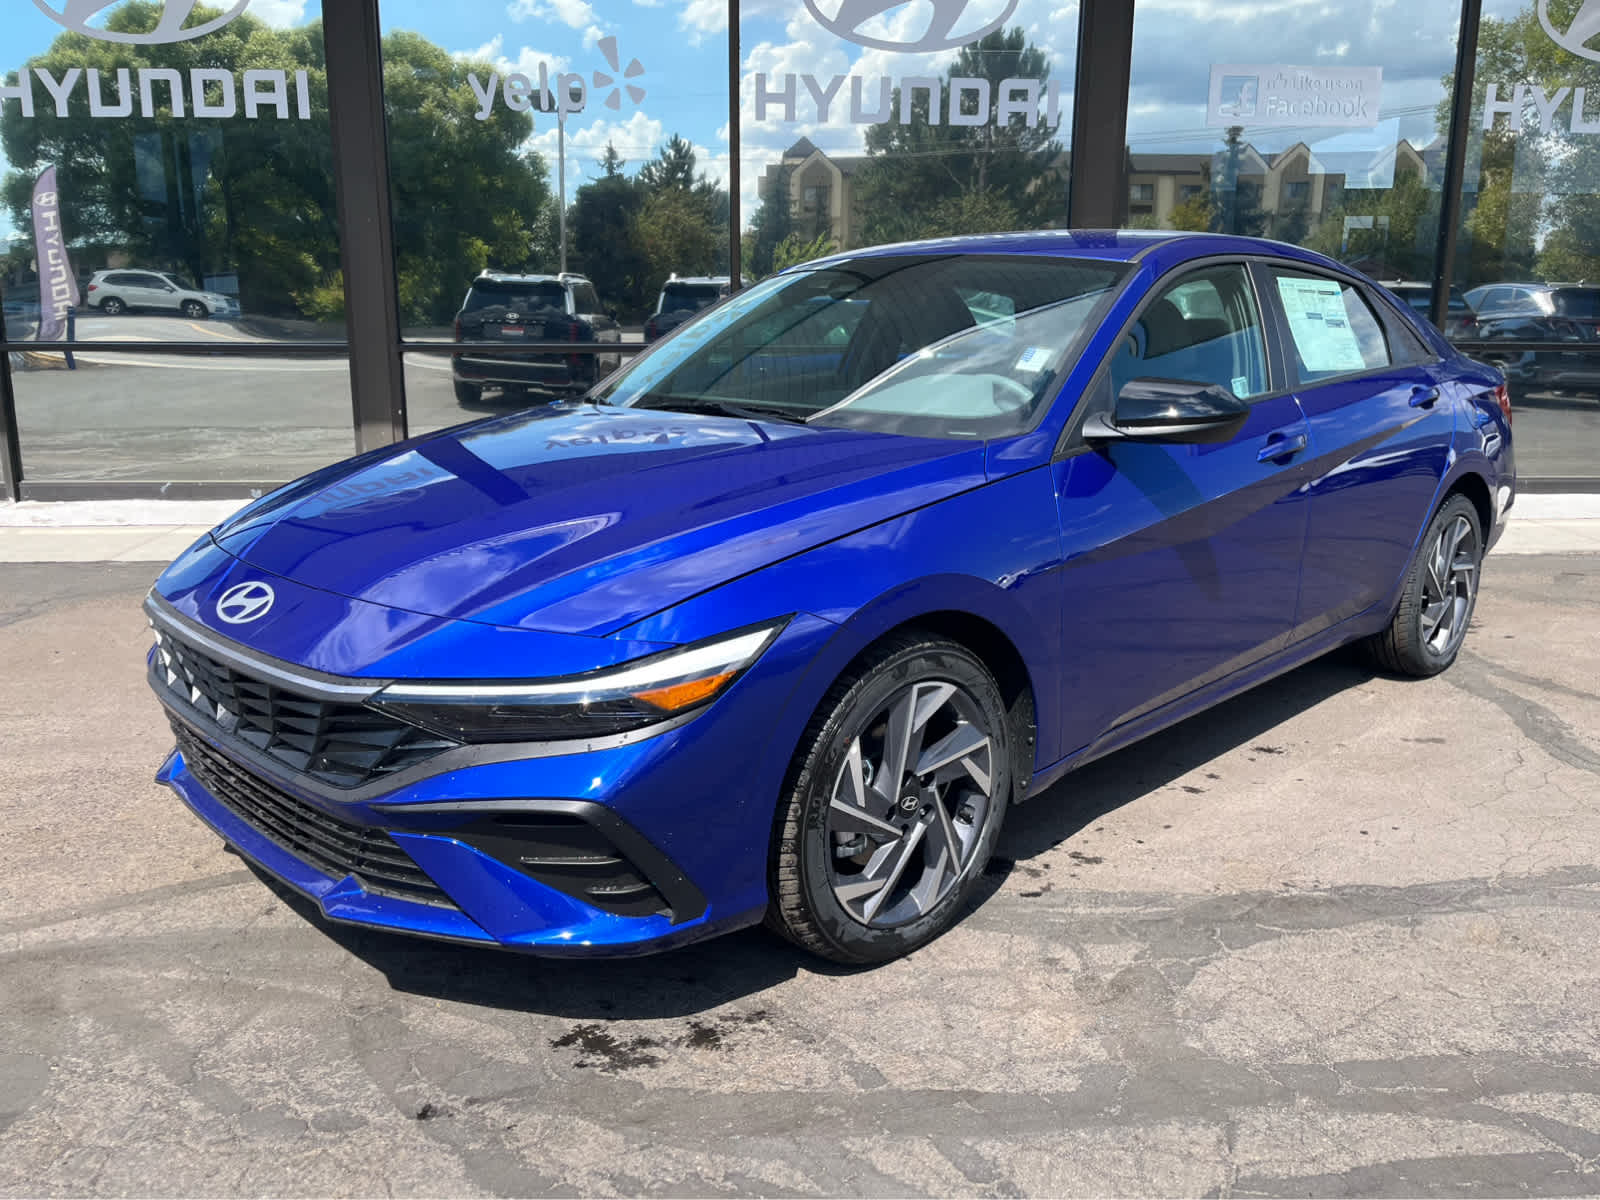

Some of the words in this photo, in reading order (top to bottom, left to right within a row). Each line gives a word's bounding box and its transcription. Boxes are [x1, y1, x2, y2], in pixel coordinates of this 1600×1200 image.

[467, 61, 586, 120] yelp
[755, 73, 1060, 127] HYUNDAI
[1266, 95, 1367, 118] Facebook
[41, 210, 71, 320] HYUNDAI
